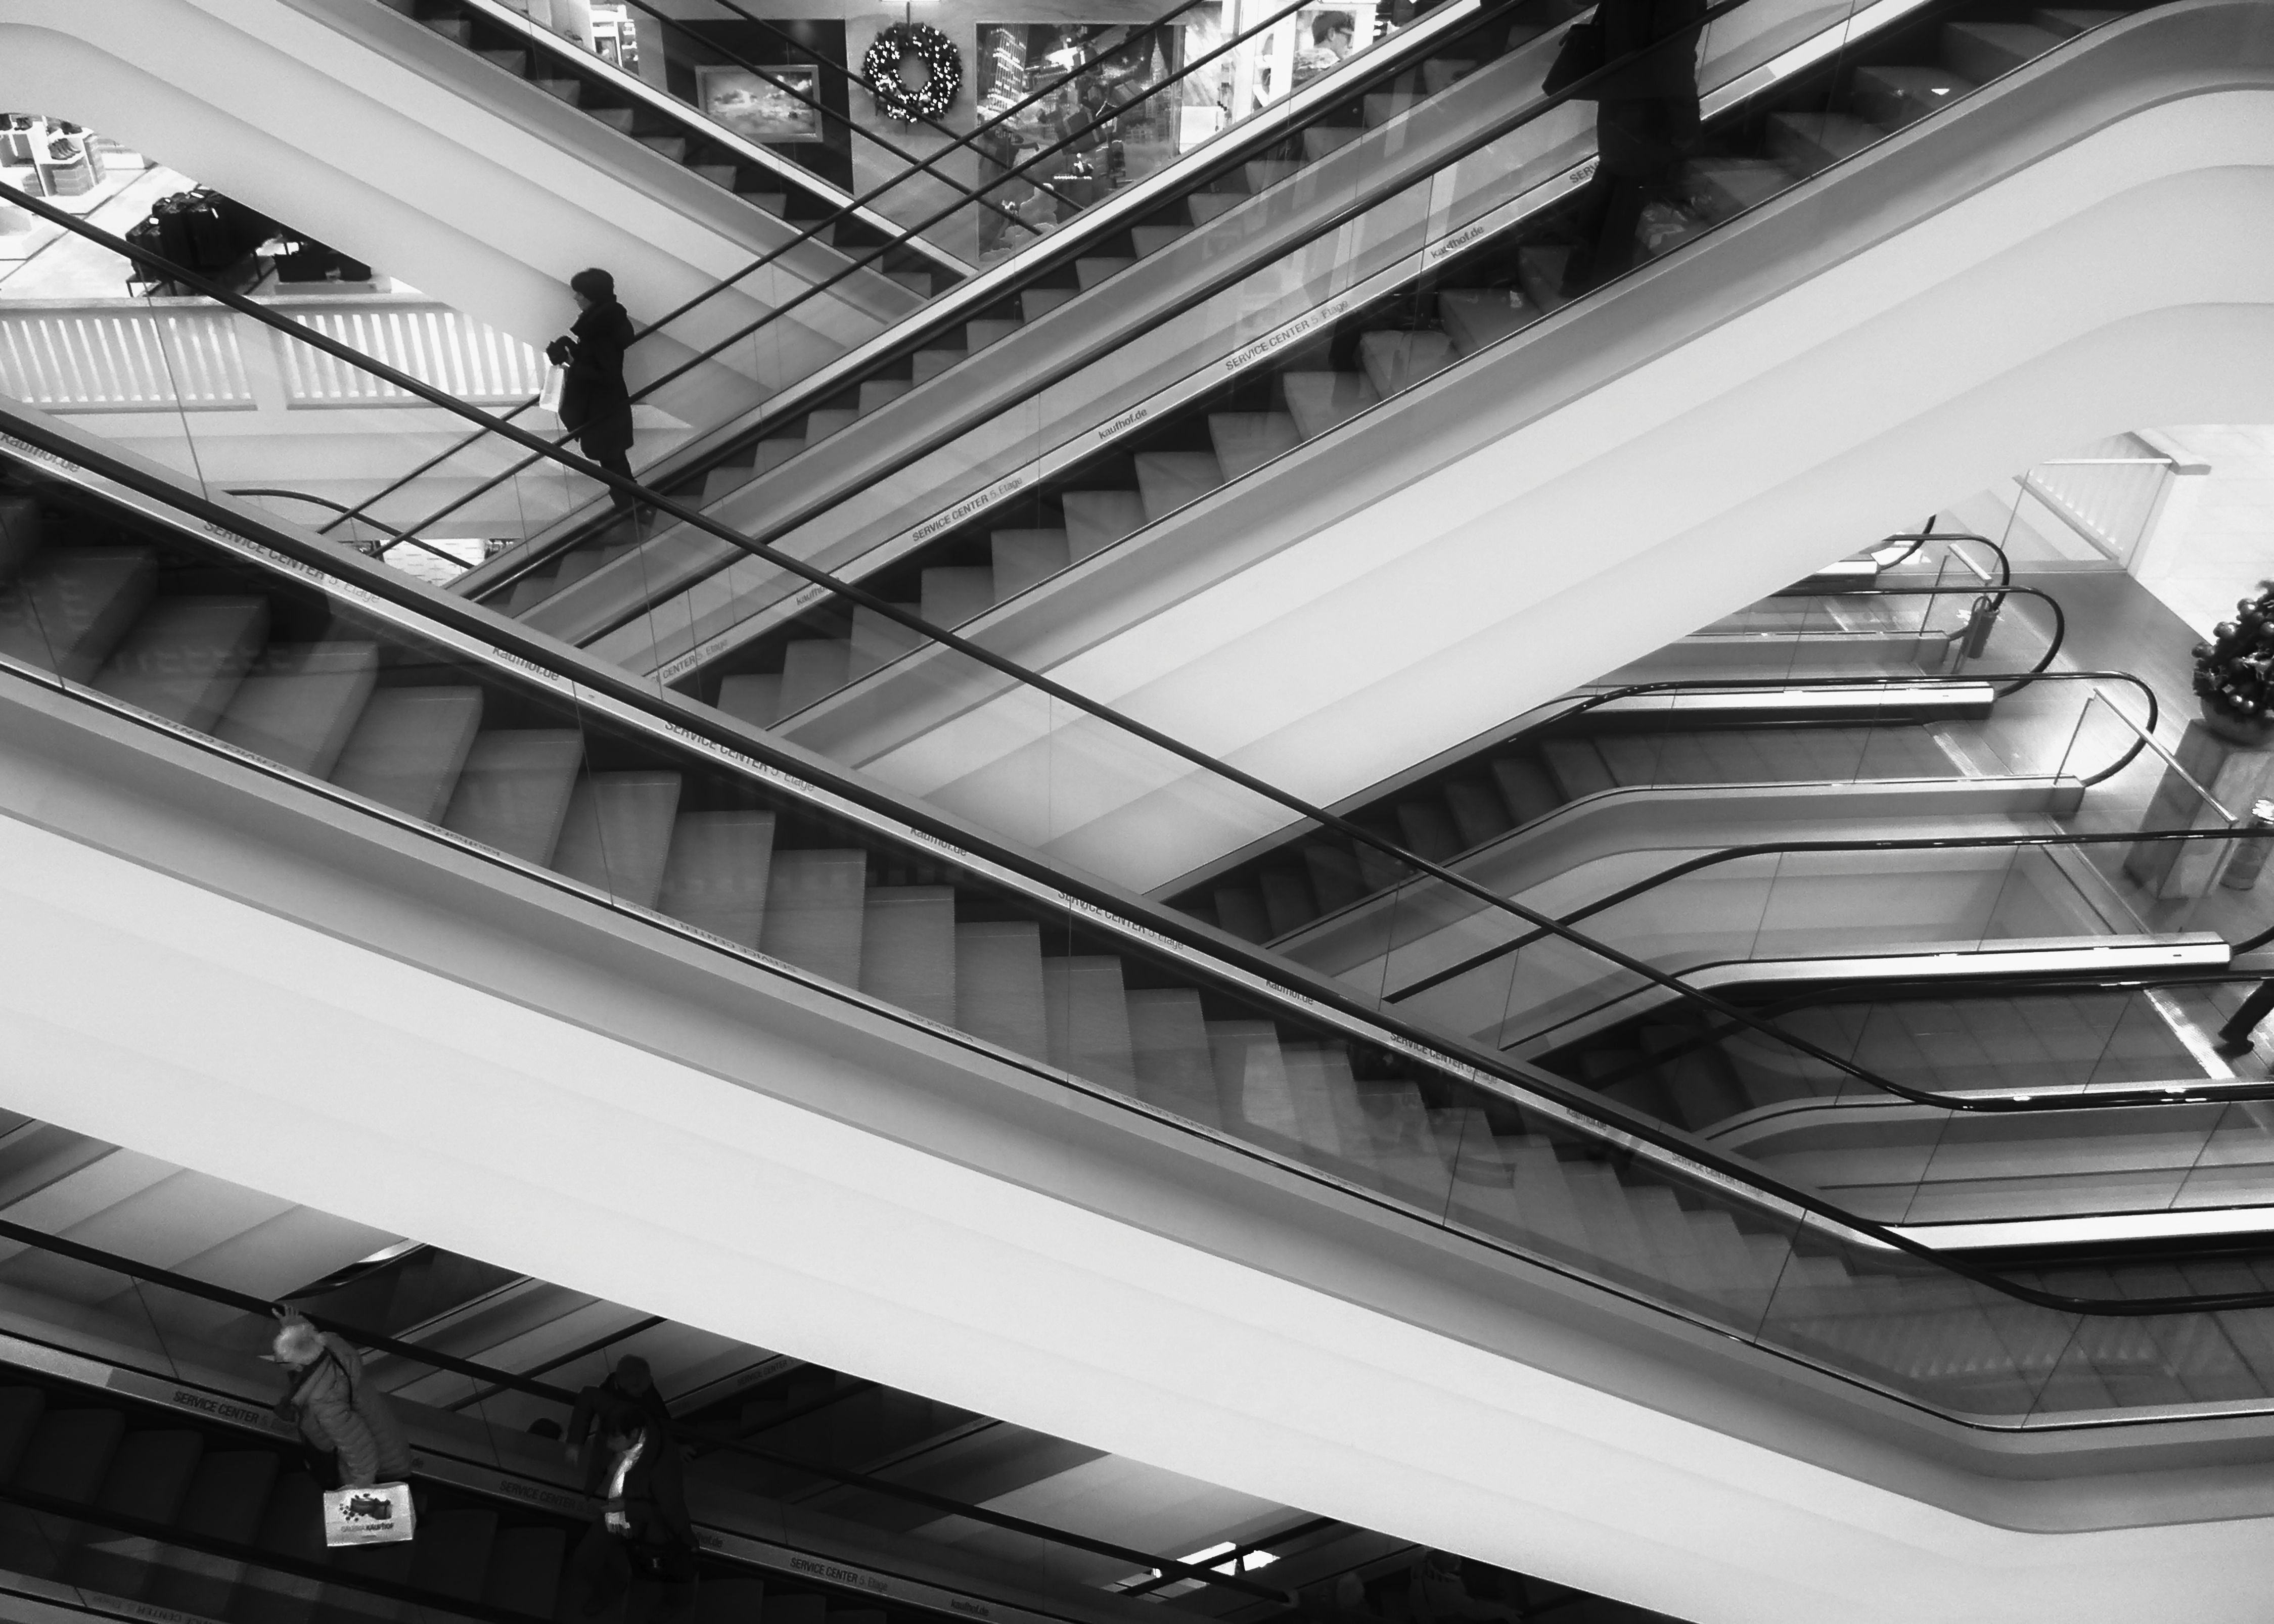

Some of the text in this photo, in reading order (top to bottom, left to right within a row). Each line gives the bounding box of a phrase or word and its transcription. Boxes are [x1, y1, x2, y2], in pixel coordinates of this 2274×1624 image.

[1431, 226, 1484, 258] kaufhof.de
[1225, 343, 1268, 370] SERVICE
[1269, 319, 1310, 347] CENTER
[1099, 409, 1147, 439] kaufhof.de
[912, 514, 951, 542] SERVICE
[952, 494, 989, 520] CENTER
[998, 478, 1022, 494] Etage
[204, 521, 267, 554] SERVICE
[268, 550, 325, 580] CENTER
[663, 652, 695, 679] CENTER
[665, 722, 717, 750] SERVICE
[720, 746, 767, 771] CENTER
[173, 1391, 259, 1424] SERVICE CENTER
[499, 1480, 575, 1508] SERVICE CENTER
[790, 1557, 825, 1574] SERVICE
[826, 1566, 858, 1584] CENTER
